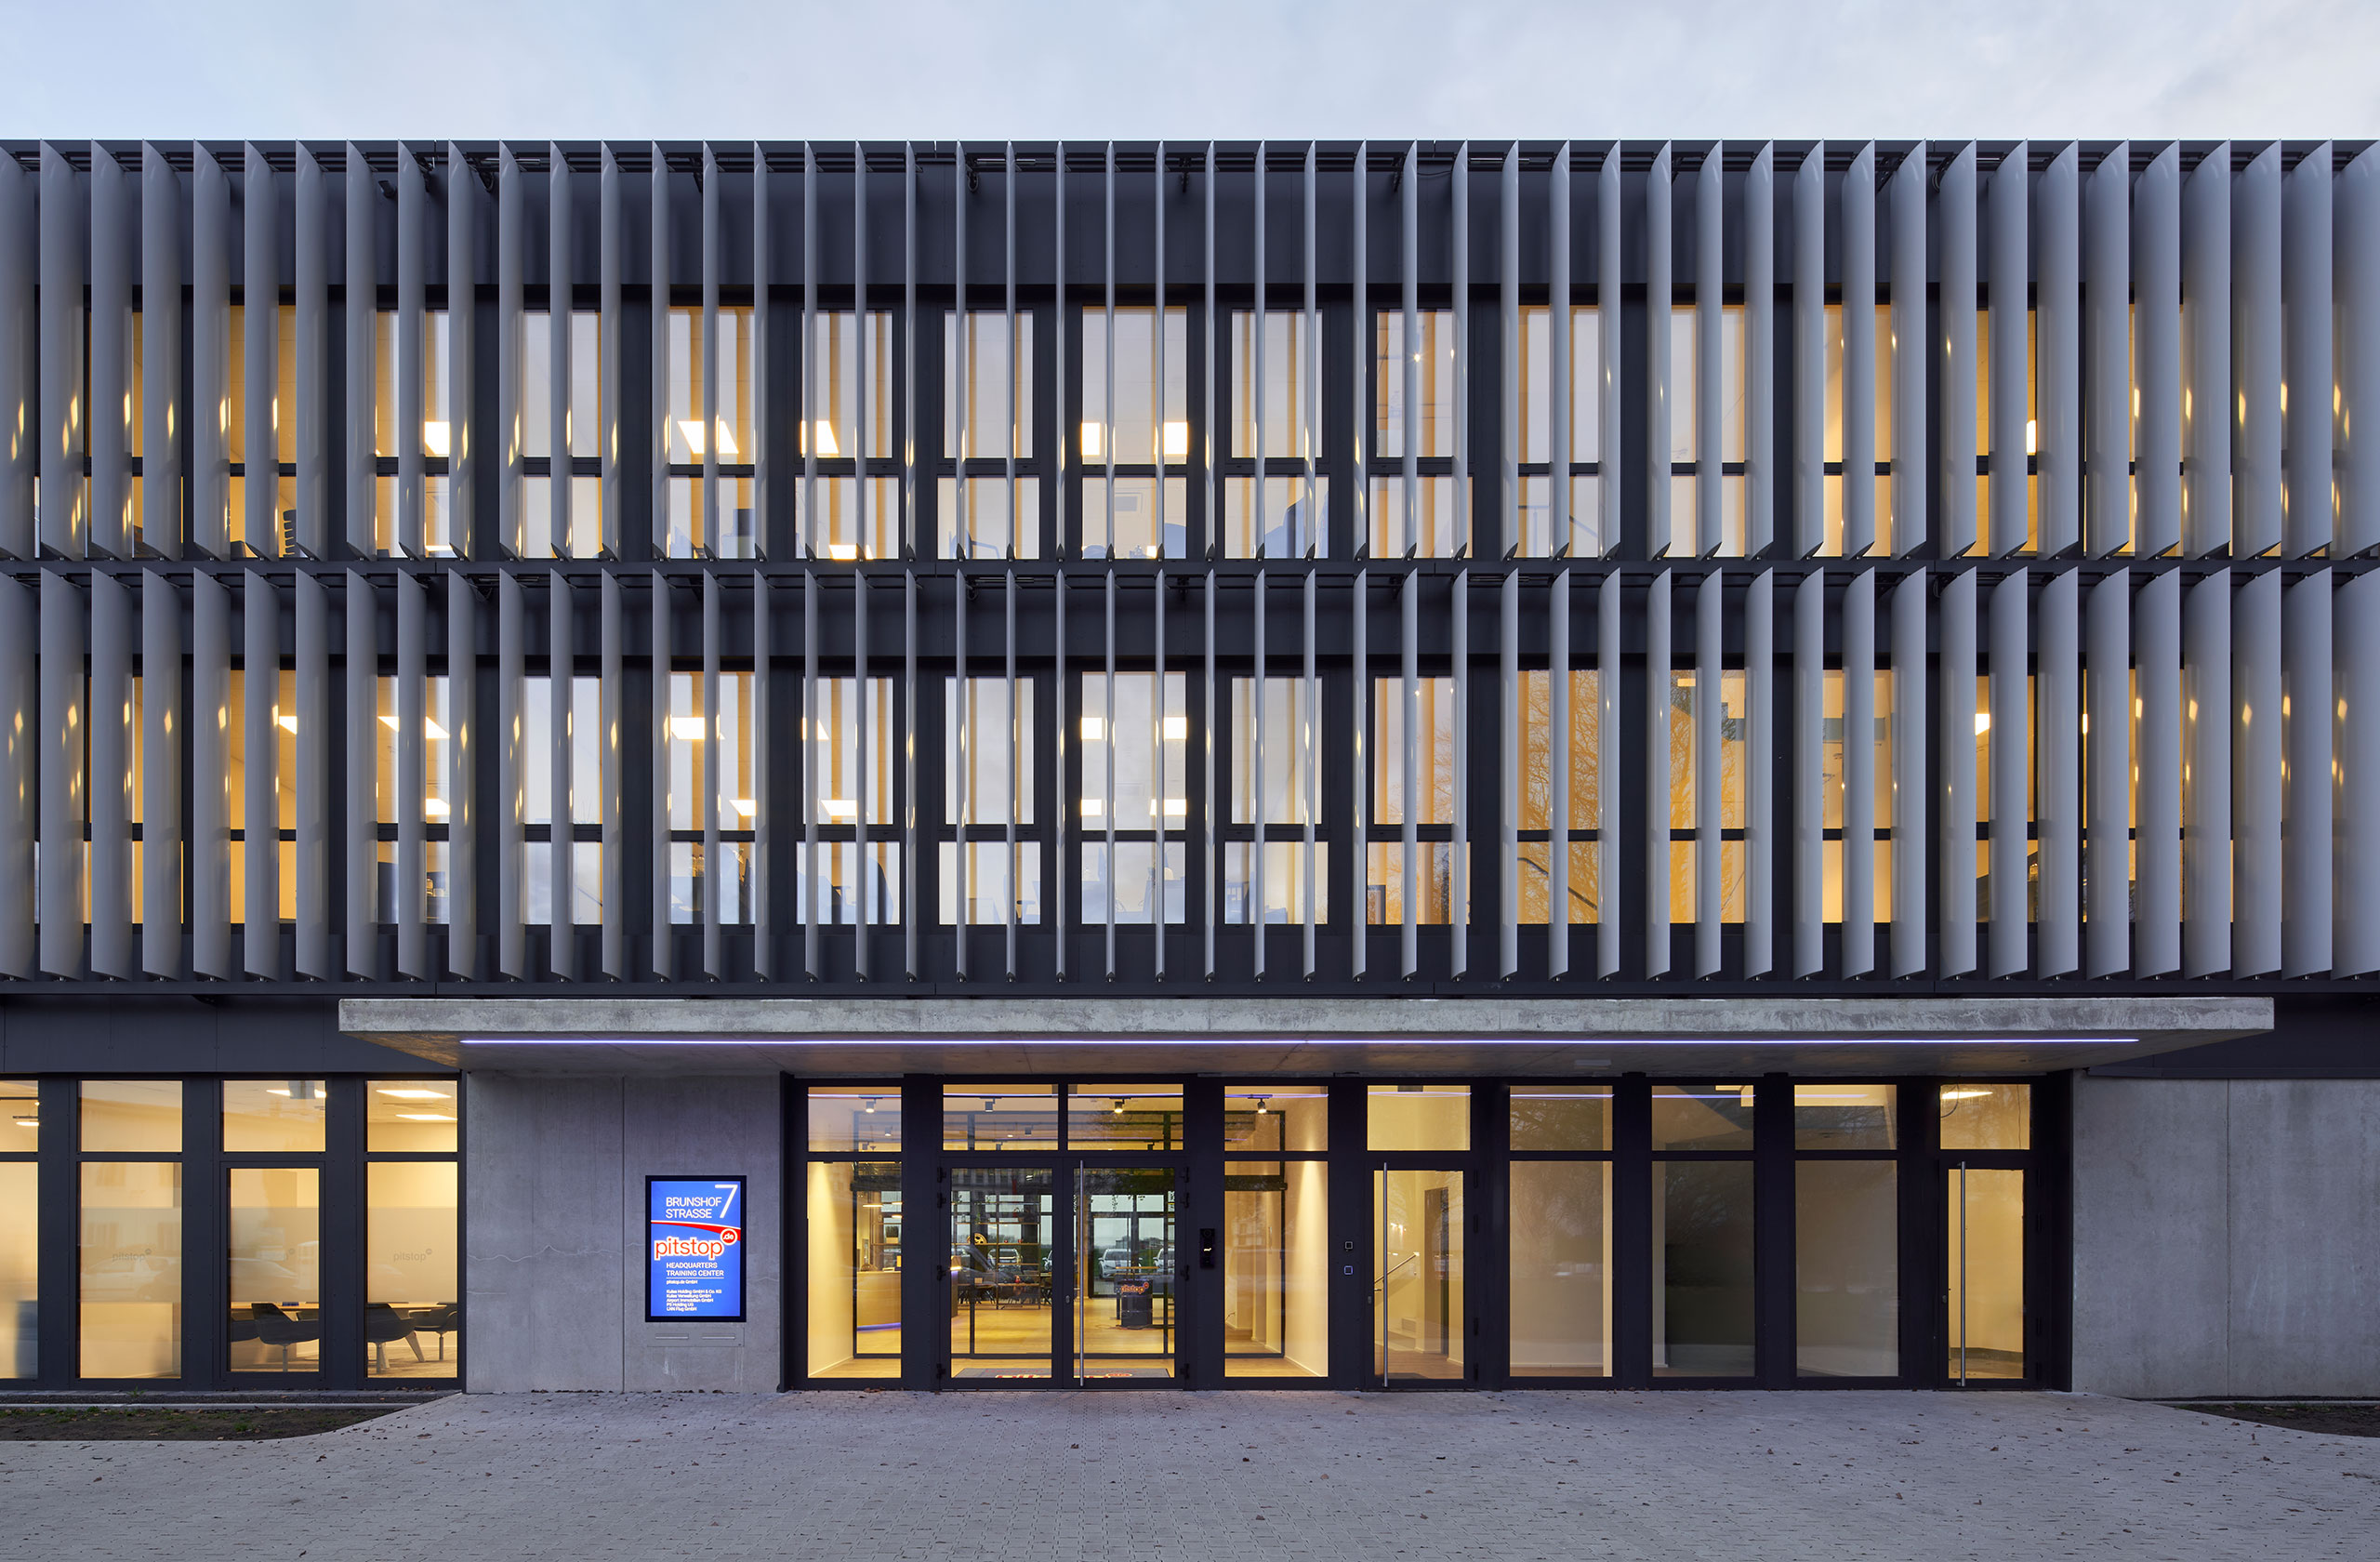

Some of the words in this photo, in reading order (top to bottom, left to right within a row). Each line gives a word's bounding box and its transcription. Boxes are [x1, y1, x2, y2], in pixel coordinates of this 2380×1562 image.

[666, 1197, 722, 1207] BRUNSHOF
[715, 1184, 738, 1219] 7
[666, 1209, 712, 1219] STRASSE
[654, 1237, 723, 1260] pitstop
[393, 1251, 427, 1263] pitstop
